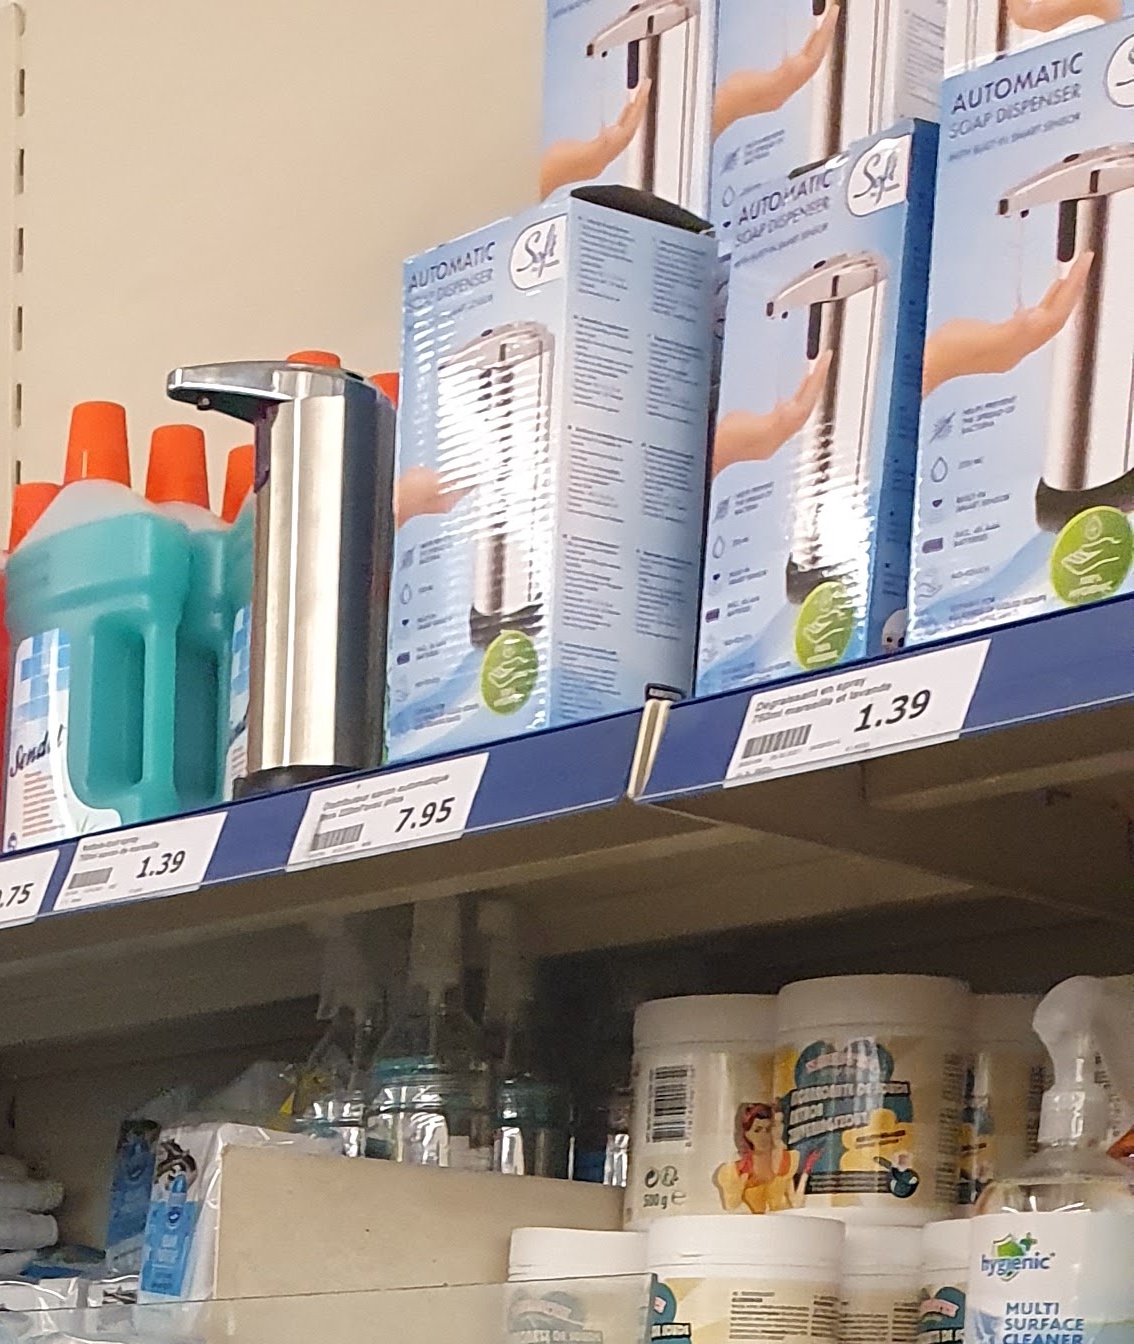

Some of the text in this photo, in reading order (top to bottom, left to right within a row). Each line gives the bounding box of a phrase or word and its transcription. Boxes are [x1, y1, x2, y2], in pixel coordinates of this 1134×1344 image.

[951, 51, 1083, 115] AUTOMATIC
[948, 83, 1081, 139] SOAP DISPENSER
[738, 169, 833, 225] AUTOMATIC
[408, 241, 495, 293] AUTOMATIC
[854, 689, 930, 732] 1.39
[395, 797, 455, 832] 7.95
[136, 850, 185, 878] 1.39
[981, 1250, 1051, 1277] hygienic
[1004, 1318, 1084, 1332] SURFACE
[1006, 1302, 1060, 1316] MULTI
